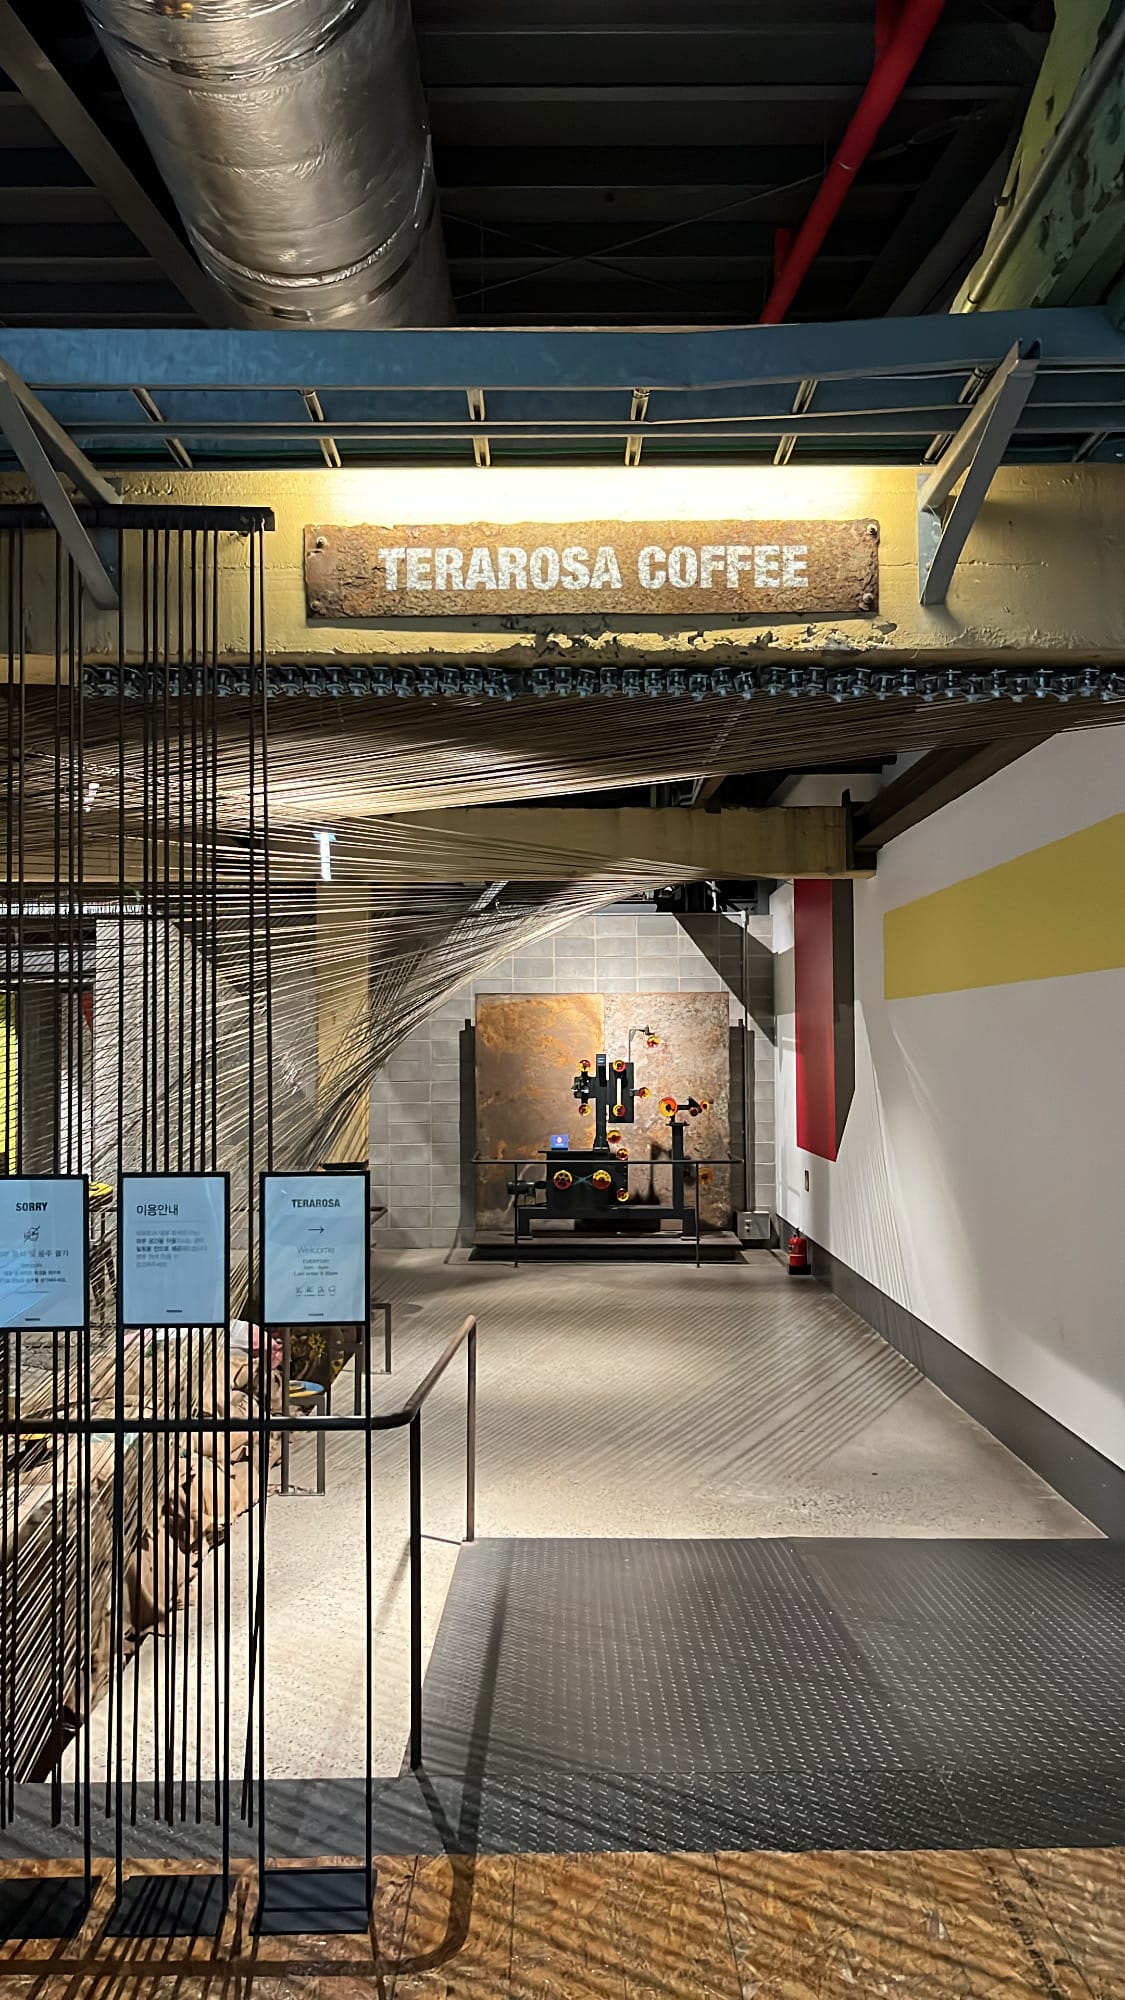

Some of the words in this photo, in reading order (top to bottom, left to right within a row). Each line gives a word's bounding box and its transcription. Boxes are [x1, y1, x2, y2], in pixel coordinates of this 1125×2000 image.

[378, 545, 622, 591] TERAROSA
[637, 545, 809, 590] COFFEE
[15, 1201, 48, 1212] SORRY
[136, 1203, 179, 1216] 이용안내
[291, 1199, 341, 1208] TERAROSA
